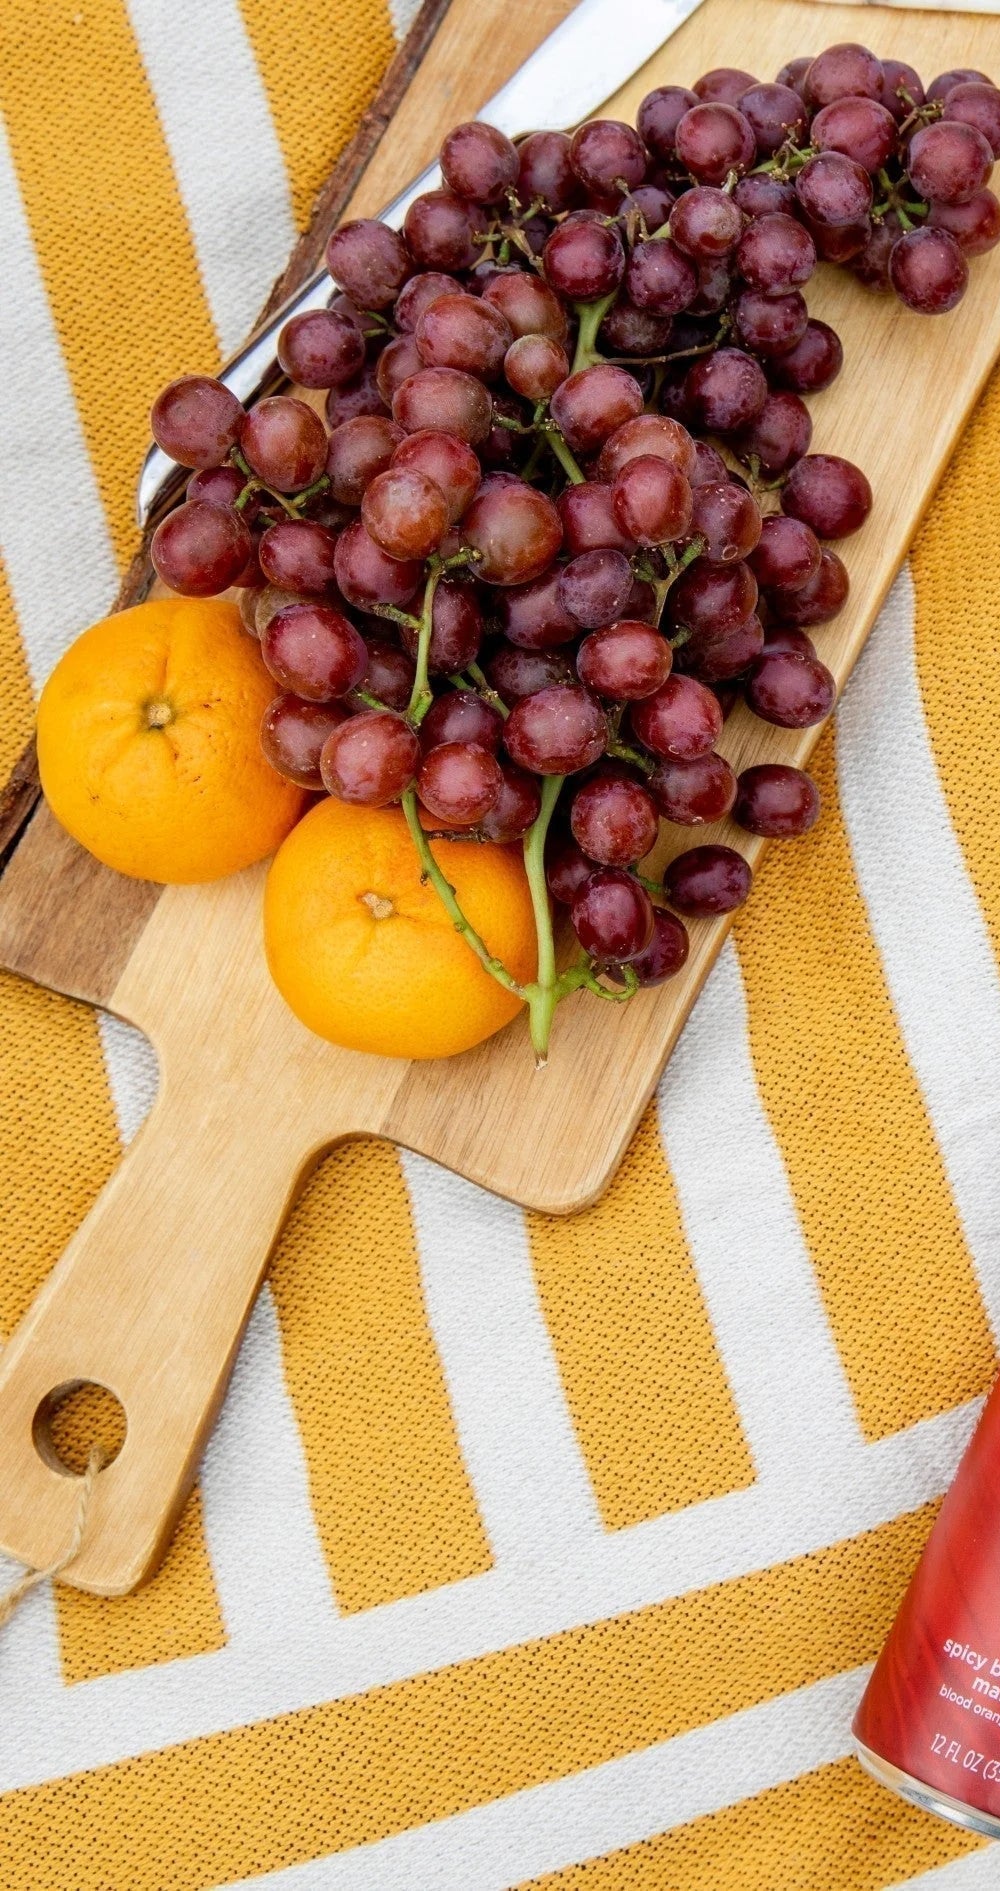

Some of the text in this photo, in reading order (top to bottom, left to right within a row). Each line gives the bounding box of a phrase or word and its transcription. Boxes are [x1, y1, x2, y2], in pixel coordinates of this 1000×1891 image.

[943, 1638, 988, 1671] spicy
[938, 1683, 972, 1710] blood
[929, 1733, 946, 1754] 12
[944, 1740, 962, 1762] FL
[962, 1749, 985, 1772] OZ
